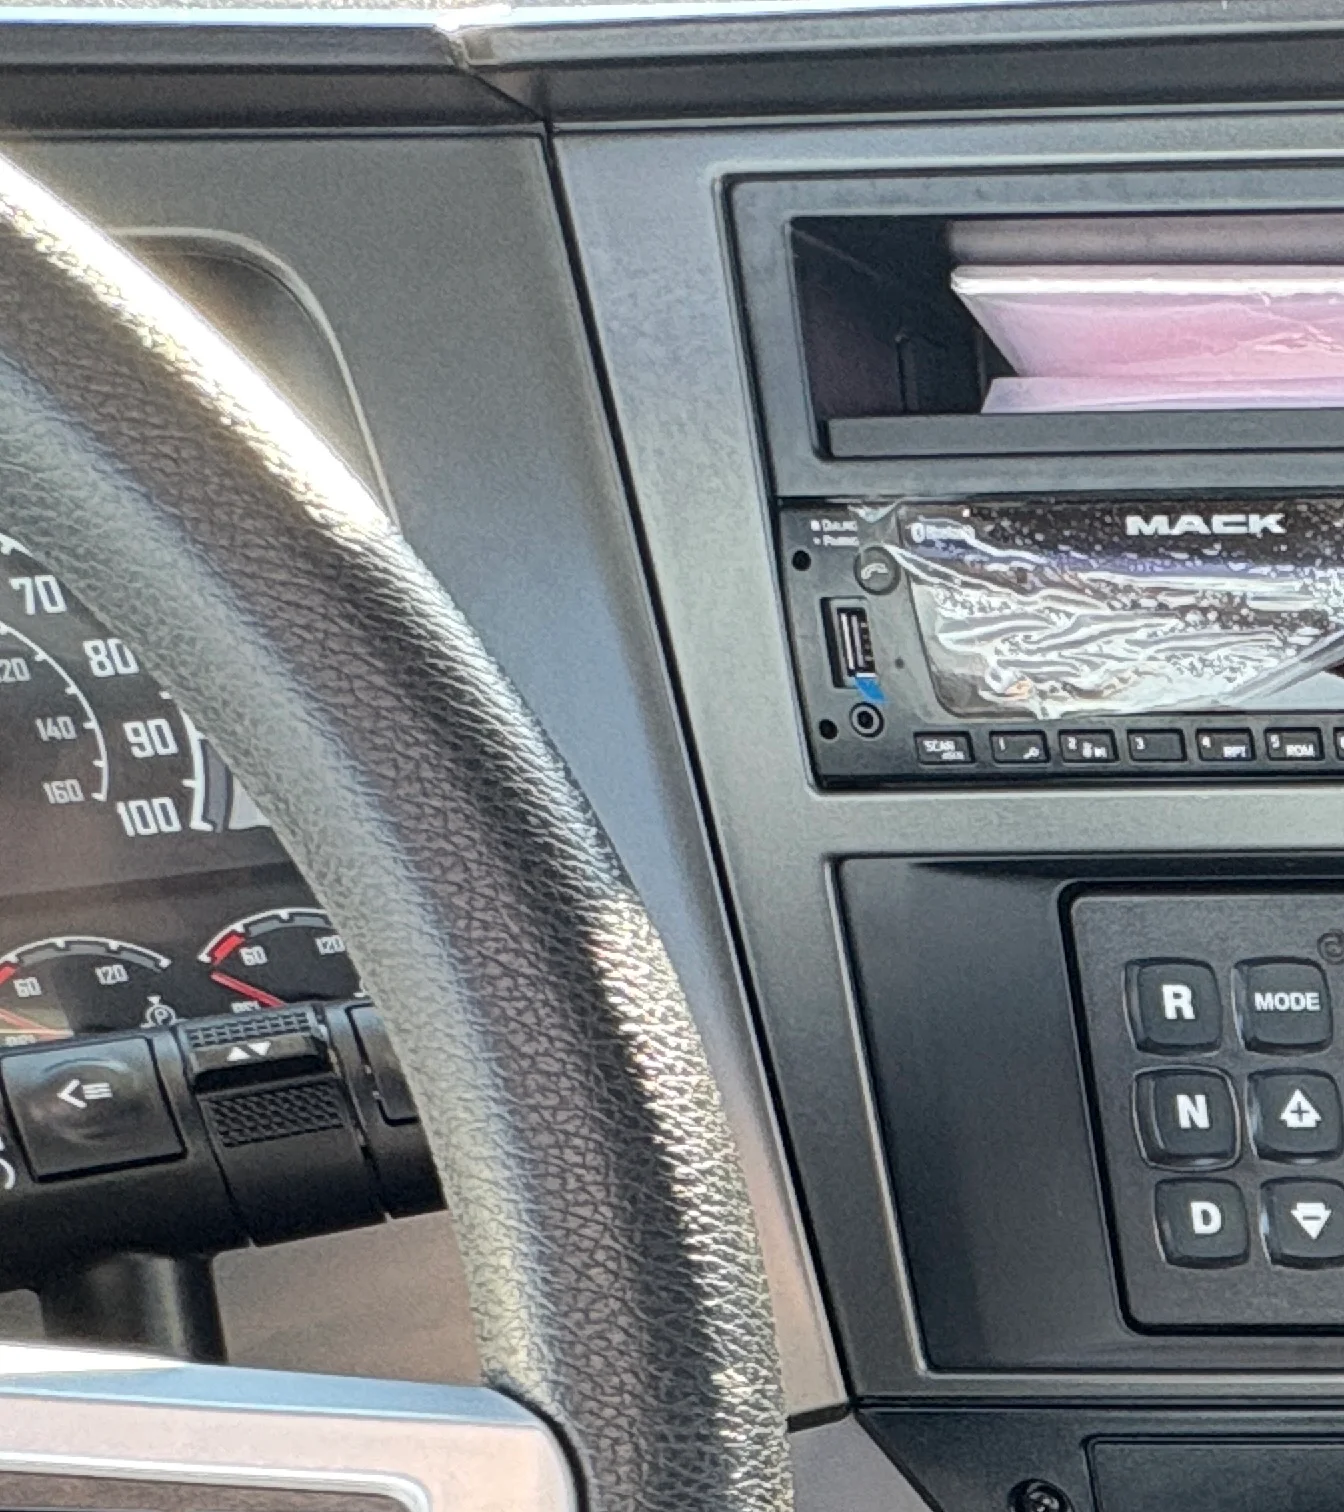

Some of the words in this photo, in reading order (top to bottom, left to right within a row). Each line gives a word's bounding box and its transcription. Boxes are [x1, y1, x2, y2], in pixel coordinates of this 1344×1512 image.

[1125, 512, 1287, 536] MACK
[9, 575, 67, 616] 70
[0, 656, 31, 684] 20
[82, 638, 140, 678] 80
[35, 715, 76, 742] 140
[122, 718, 179, 759] 90
[1135, 736, 1145, 750] 3
[42, 778, 85, 804] 160
[116, 796, 182, 837] 100
[240, 945, 268, 966] 60
[13, 977, 42, 998] 60
[95, 964, 129, 985] 120
[1162, 984, 1195, 1020] R
[1254, 992, 1321, 1012] MODE
[1176, 1094, 1210, 1129] N
[1190, 1201, 1222, 1234] D
